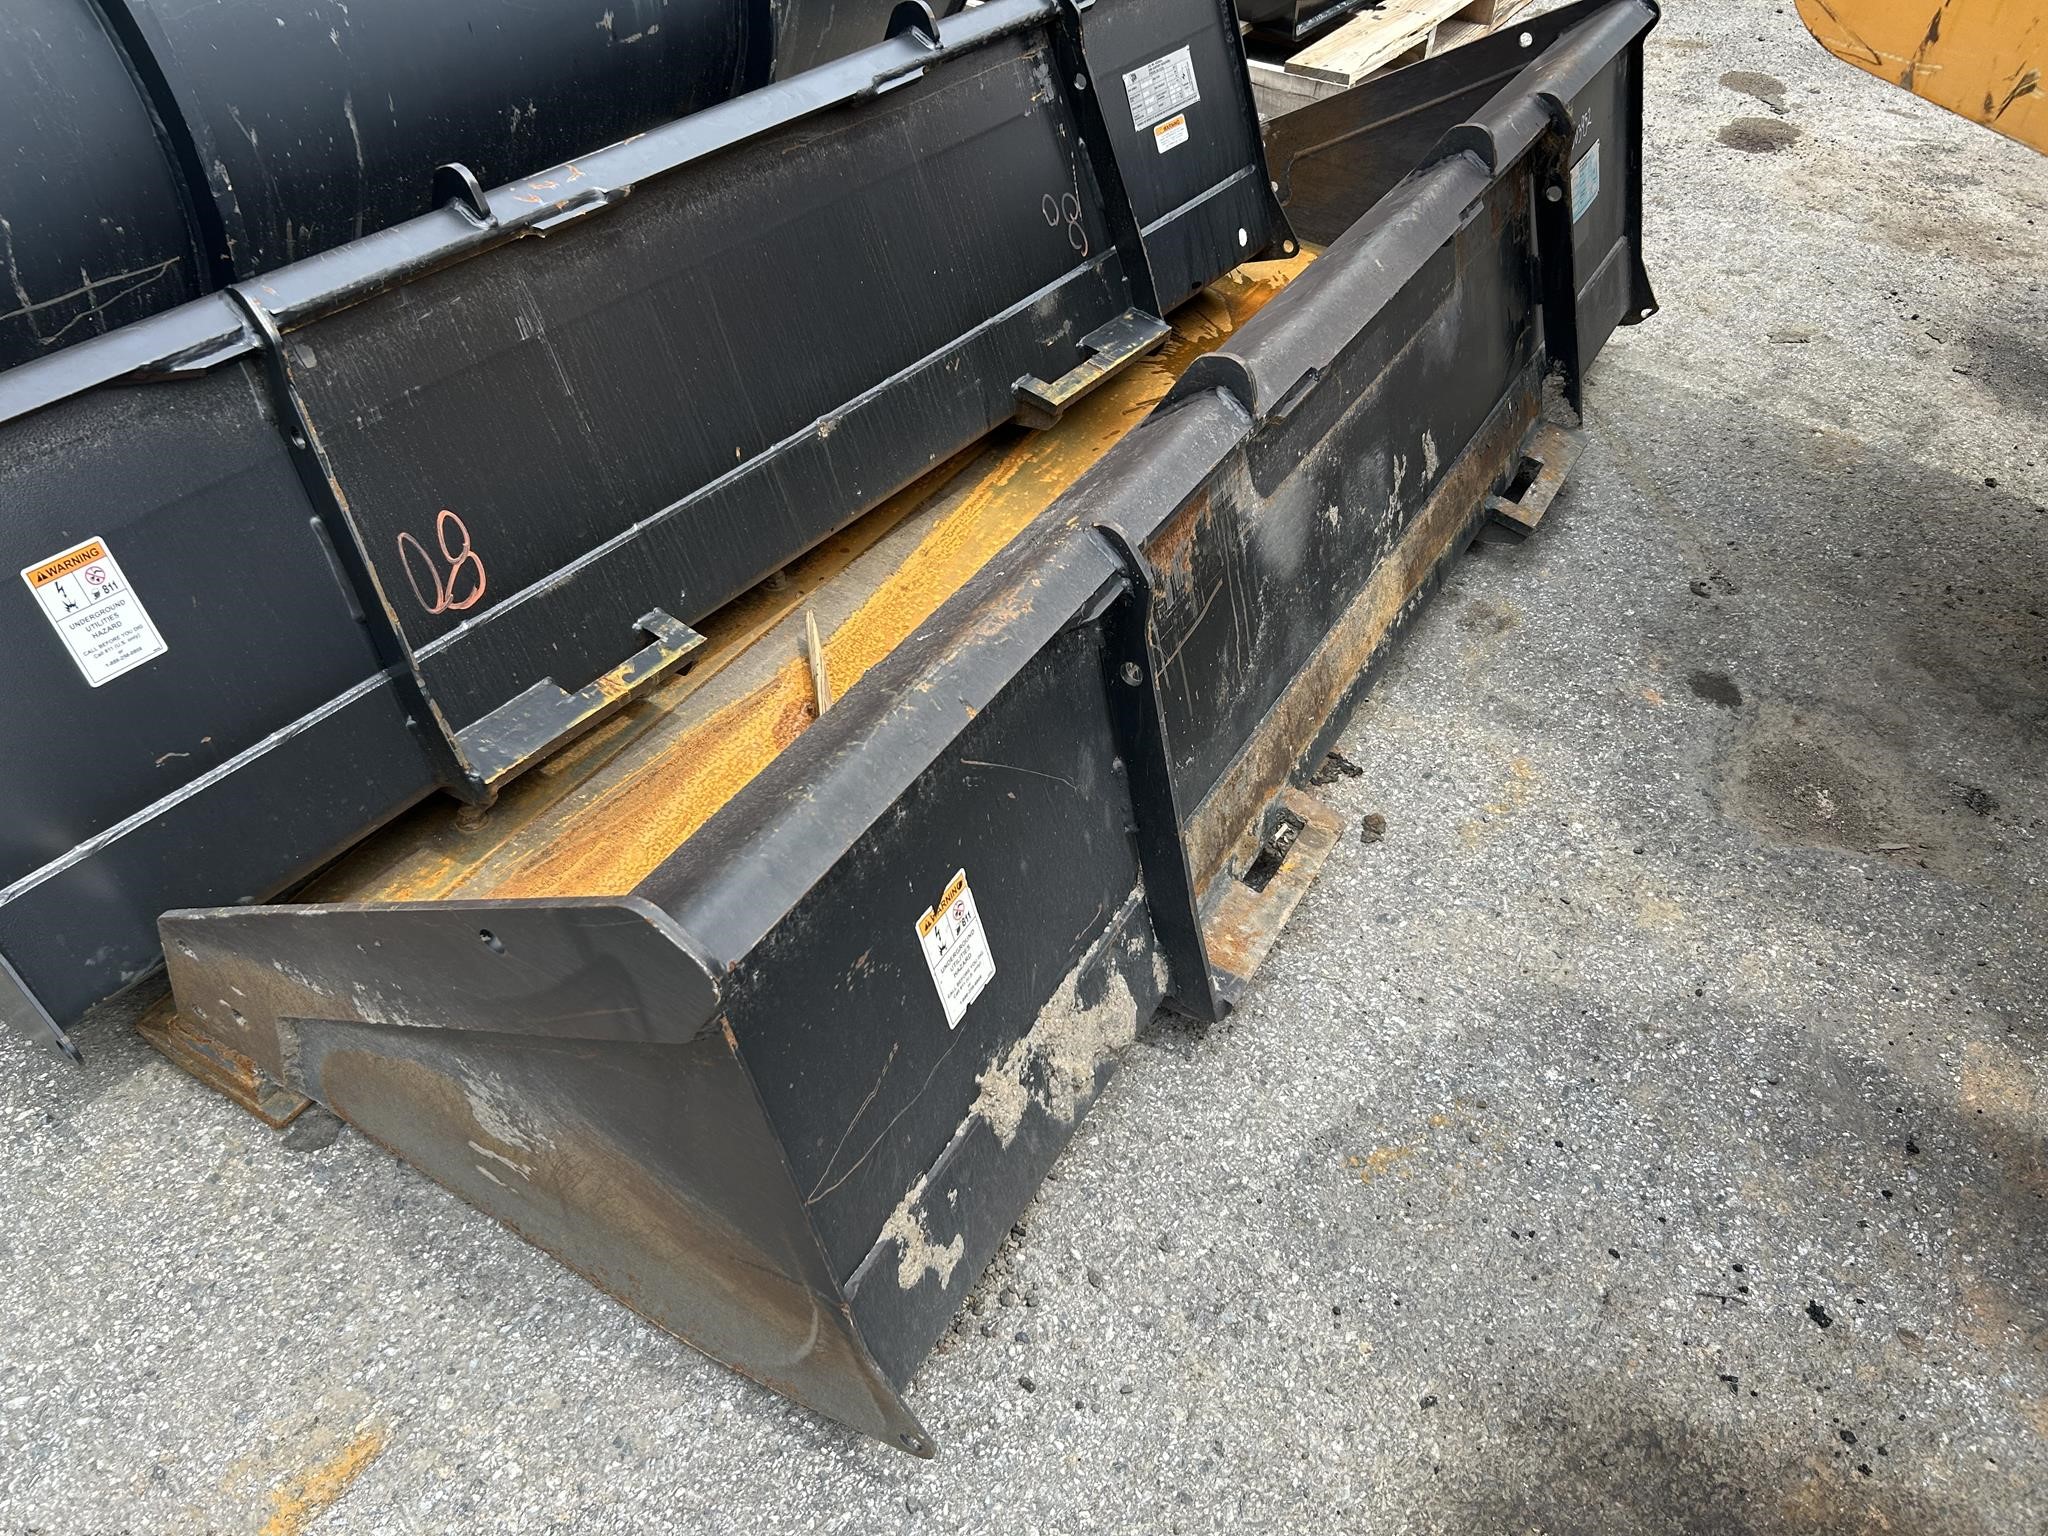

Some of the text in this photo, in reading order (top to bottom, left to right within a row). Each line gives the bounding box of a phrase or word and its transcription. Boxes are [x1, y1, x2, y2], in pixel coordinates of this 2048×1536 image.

[1042, 192, 1089, 257] 08
[45, 547, 100, 578] WARNING
[397, 509, 487, 615] 08
[102, 581, 119, 595] 811
[69, 599, 126, 630] UNDERGROUND
[85, 612, 120, 633] UTILITIES
[82, 647, 98, 657] CALL
[98, 635, 121, 648] BEFORE
[121, 629, 134, 637] YOU
[91, 621, 123, 639] HAZARD
[961, 911, 971, 927] 811
[940, 929, 975, 974] UNDERGROUND
[950, 944, 971, 972] UTILITIES
[953, 953, 972, 978] HAZARD
